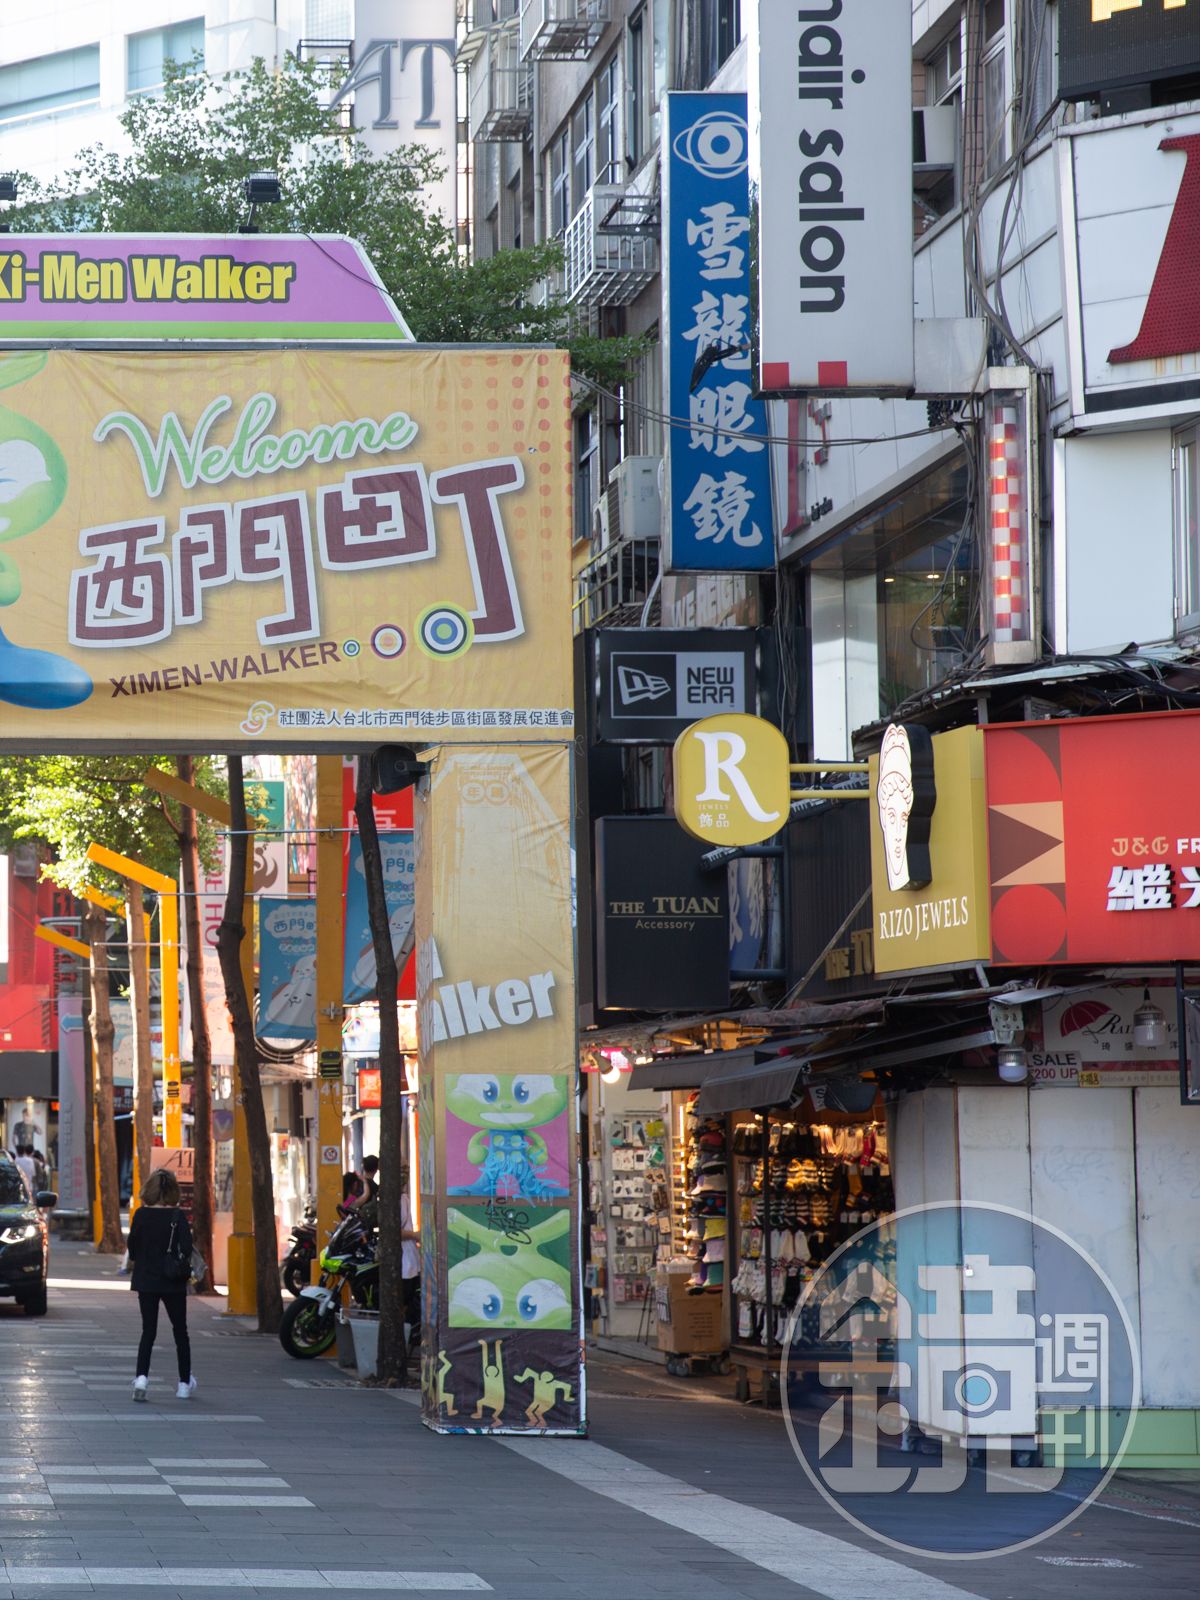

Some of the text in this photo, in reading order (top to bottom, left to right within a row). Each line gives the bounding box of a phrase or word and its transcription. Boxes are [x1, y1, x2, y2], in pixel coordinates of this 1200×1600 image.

[799, 128, 865, 313] salon
[131, 256, 295, 302] Walker
[681, 202, 765, 547] 雪龍眼鏡
[94, 392, 418, 498] Welcome
[69, 456, 525, 649] 西門町
[109, 641, 341, 698] XIMEN-WALKER
[687, 667, 734, 684] NEW
[687, 685, 734, 704] ERA
[693, 731, 780, 823] R
[698, 813, 729, 828] 飾品
[1111, 836, 1169, 856] J&G
[609, 897, 720, 914] THE TUAN
[635, 919, 696, 931] Accessory
[880, 896, 969, 941] RIZO JEWELS
[1033, 1053, 1077, 1067] SALE
